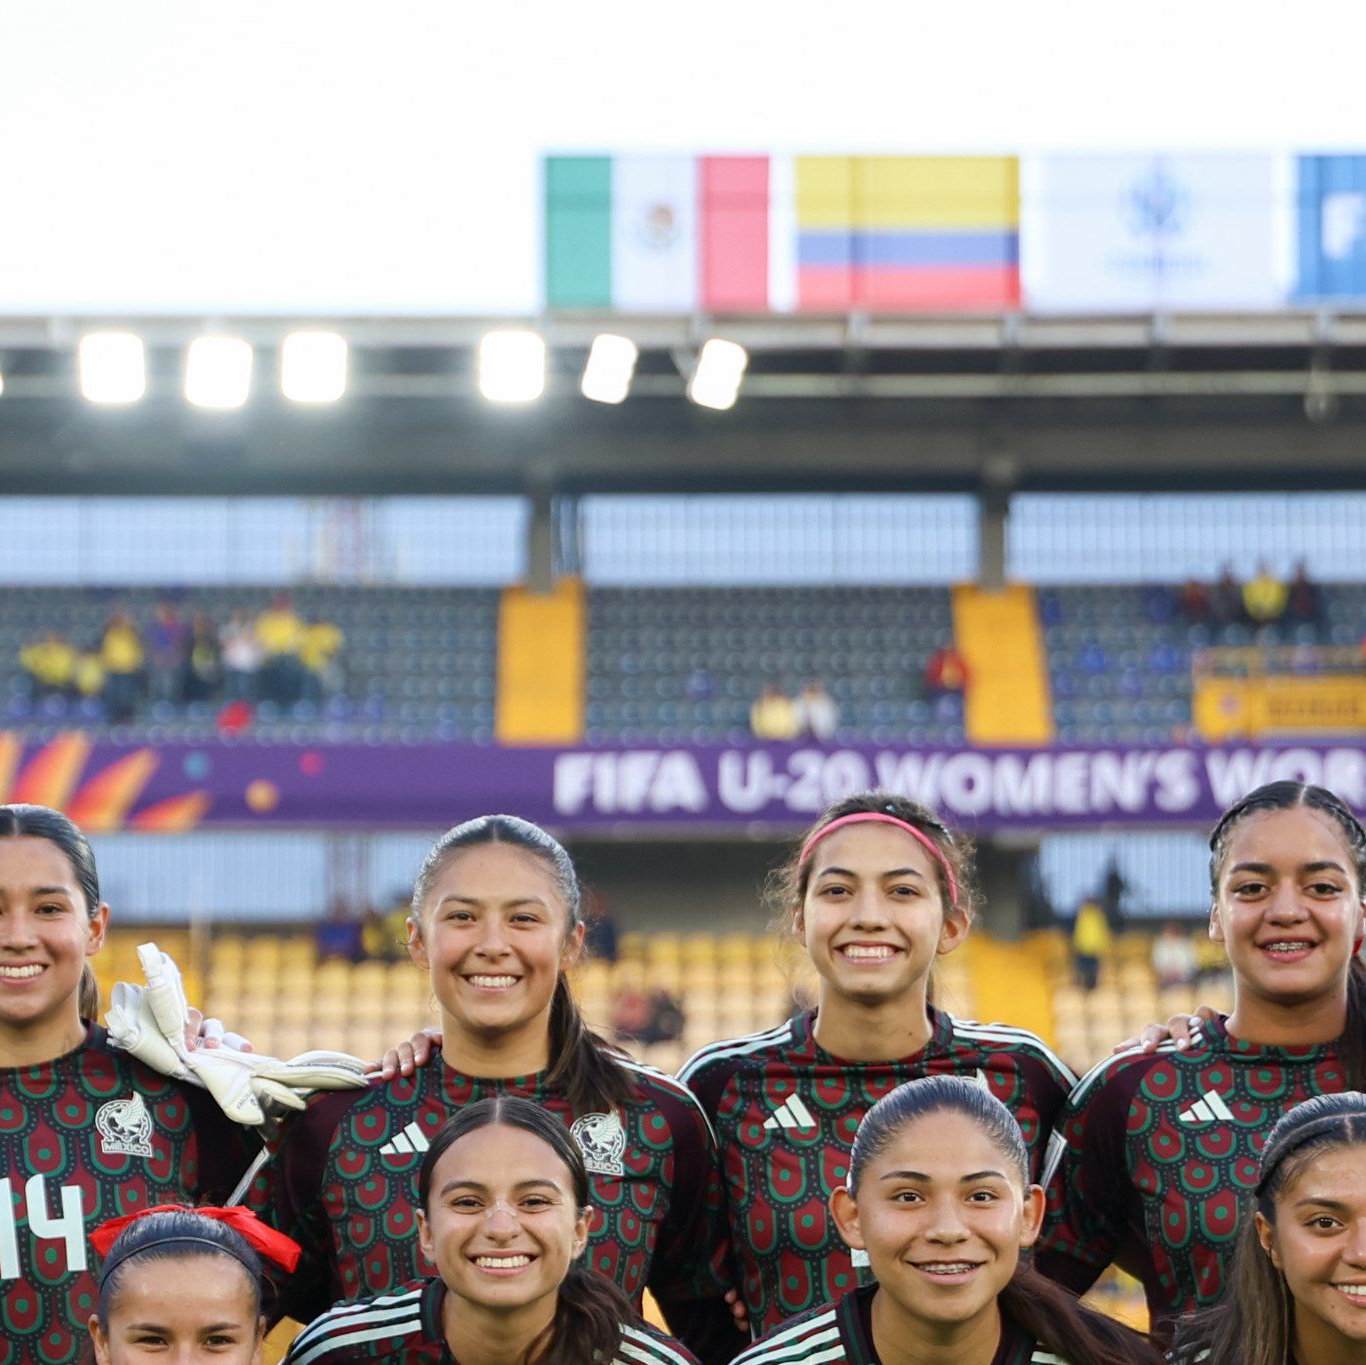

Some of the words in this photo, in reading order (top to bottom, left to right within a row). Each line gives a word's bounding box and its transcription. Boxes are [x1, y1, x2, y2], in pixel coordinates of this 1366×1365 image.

[552, 751, 707, 815] FIFA
[718, 750, 868, 812] U-20
[874, 750, 1198, 816] WOMEN'S
[584, 1157, 621, 1173] ÉXICO
